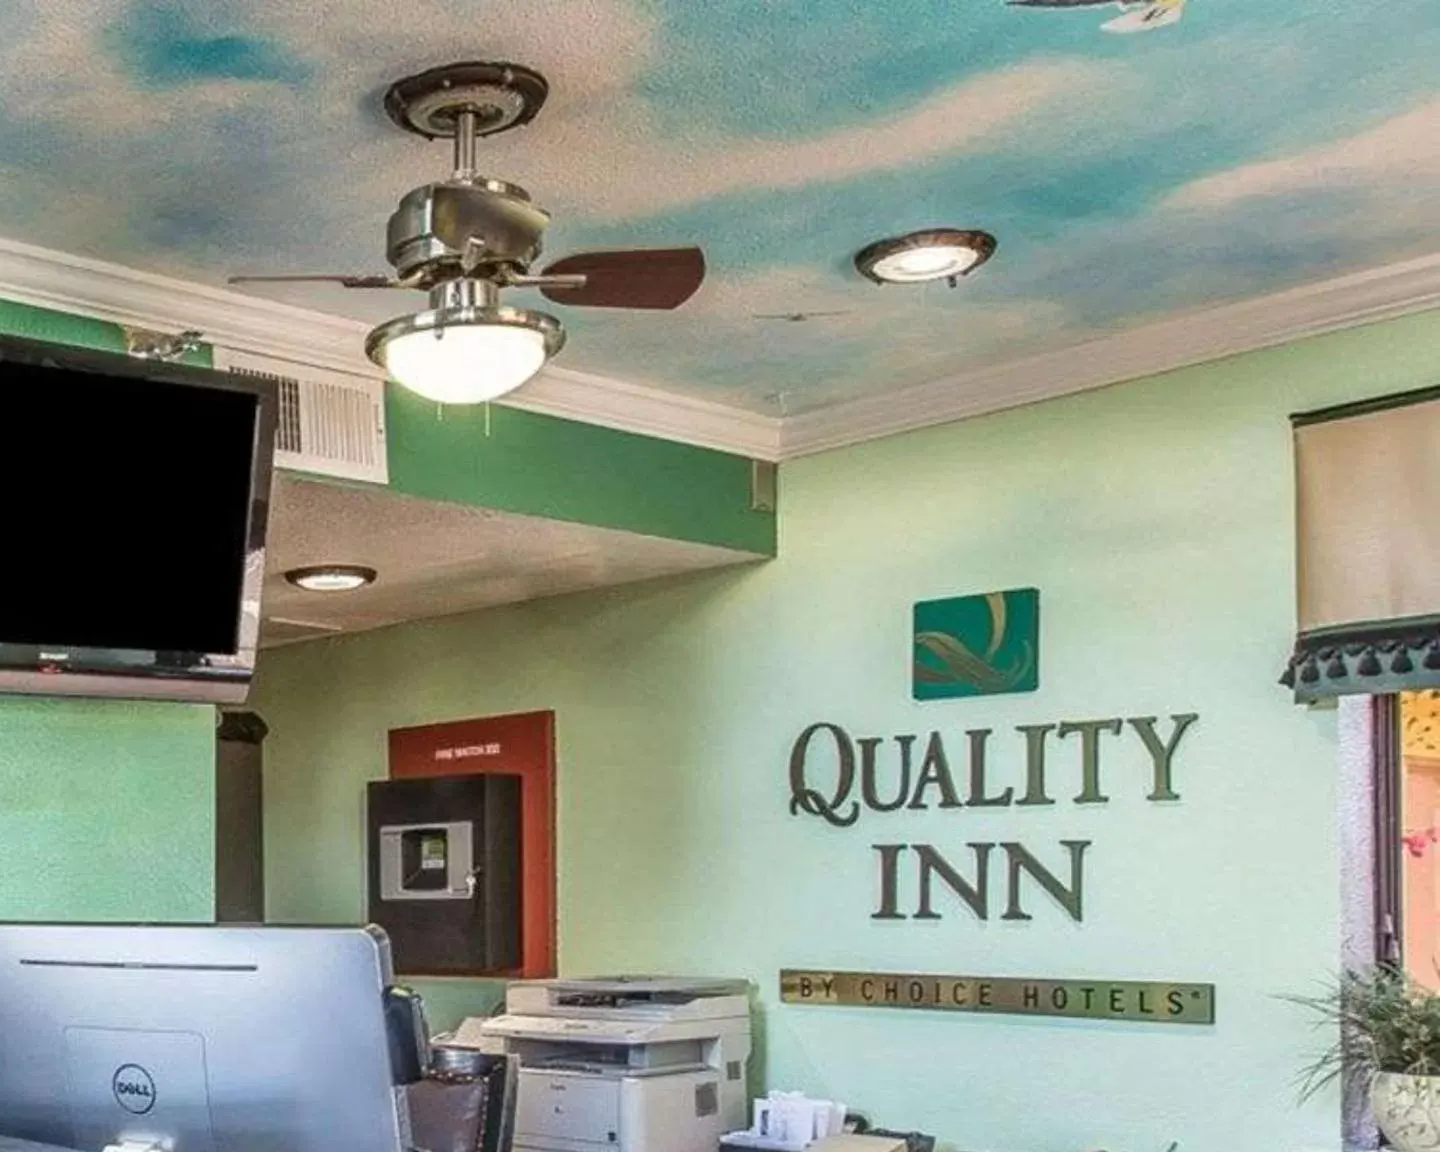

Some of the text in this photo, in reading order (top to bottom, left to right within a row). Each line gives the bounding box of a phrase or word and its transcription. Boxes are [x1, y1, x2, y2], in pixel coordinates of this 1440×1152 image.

[789, 711, 1200, 828] QUALITY
[870, 840, 1092, 923] INN
[799, 977, 837, 999] BY
[861, 979, 993, 1007] CHOICE
[117, 1081, 152, 1097] DELL
